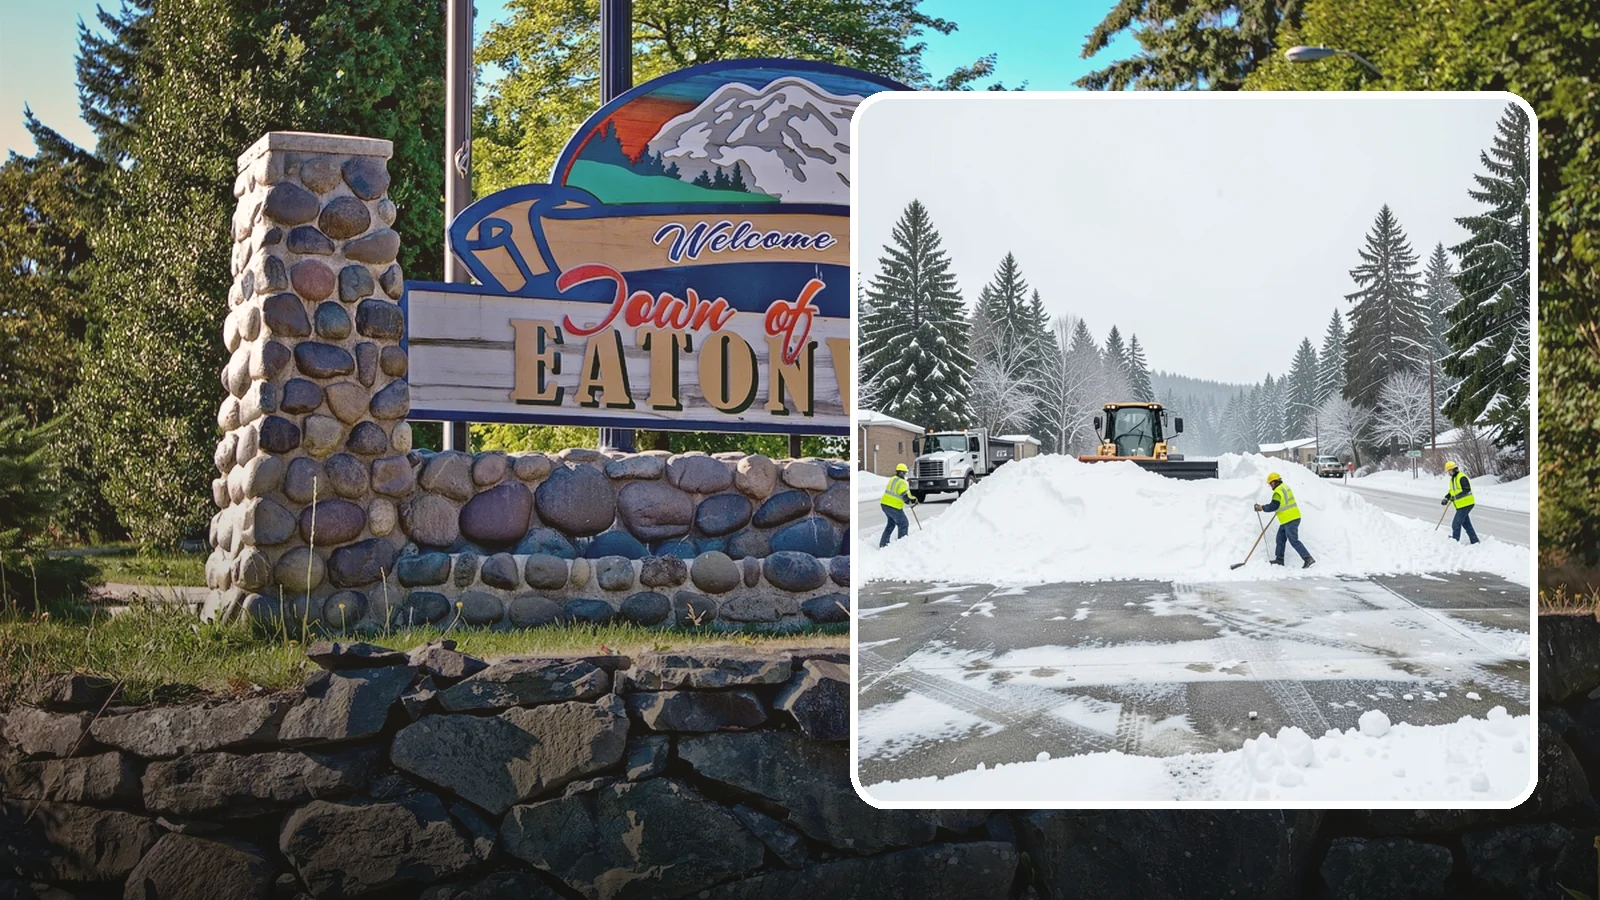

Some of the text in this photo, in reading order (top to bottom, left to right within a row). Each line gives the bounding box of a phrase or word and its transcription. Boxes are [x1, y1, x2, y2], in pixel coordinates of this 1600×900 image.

[654, 220, 837, 263] Welcome
[556, 263, 826, 365] Town of
